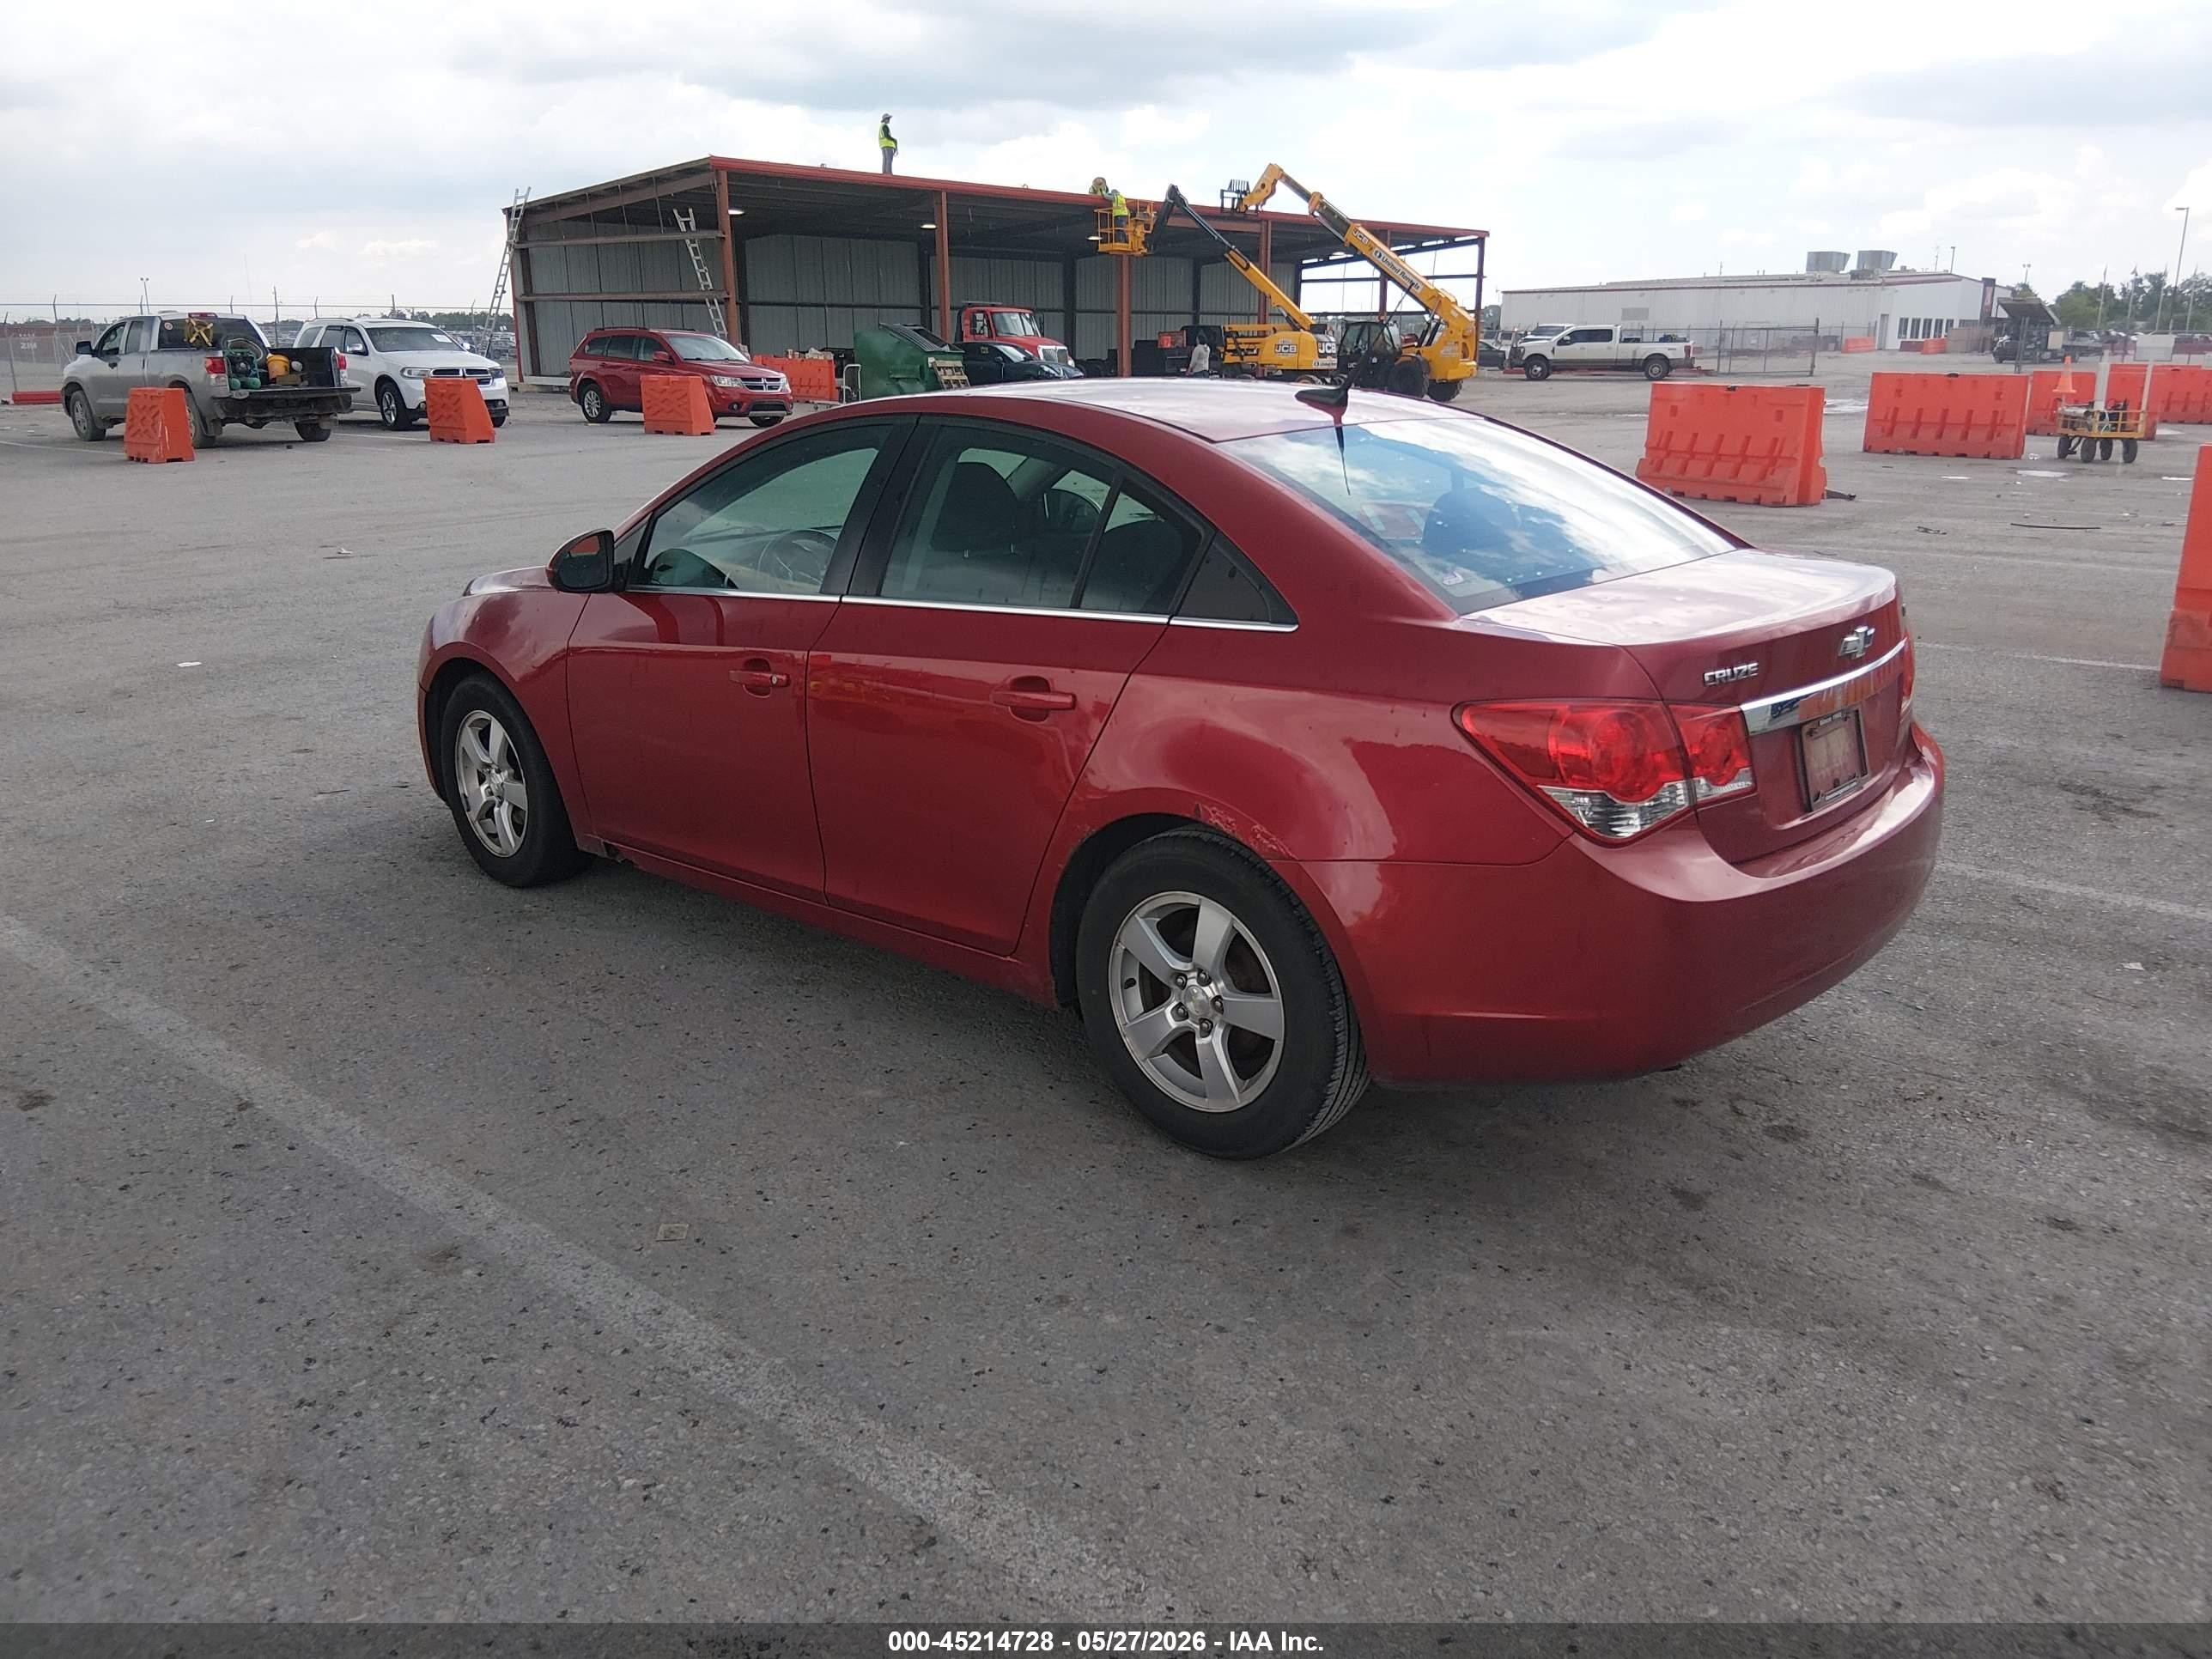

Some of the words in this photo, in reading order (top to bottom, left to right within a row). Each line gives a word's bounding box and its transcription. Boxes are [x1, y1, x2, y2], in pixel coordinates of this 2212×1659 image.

[1352, 228, 1370, 245] JCB
[1382, 257, 1401, 274] United
[1275, 344, 1297, 353] JCB
[1318, 343, 1337, 354] JCB
[1704, 662, 1759, 686] CRUZE
